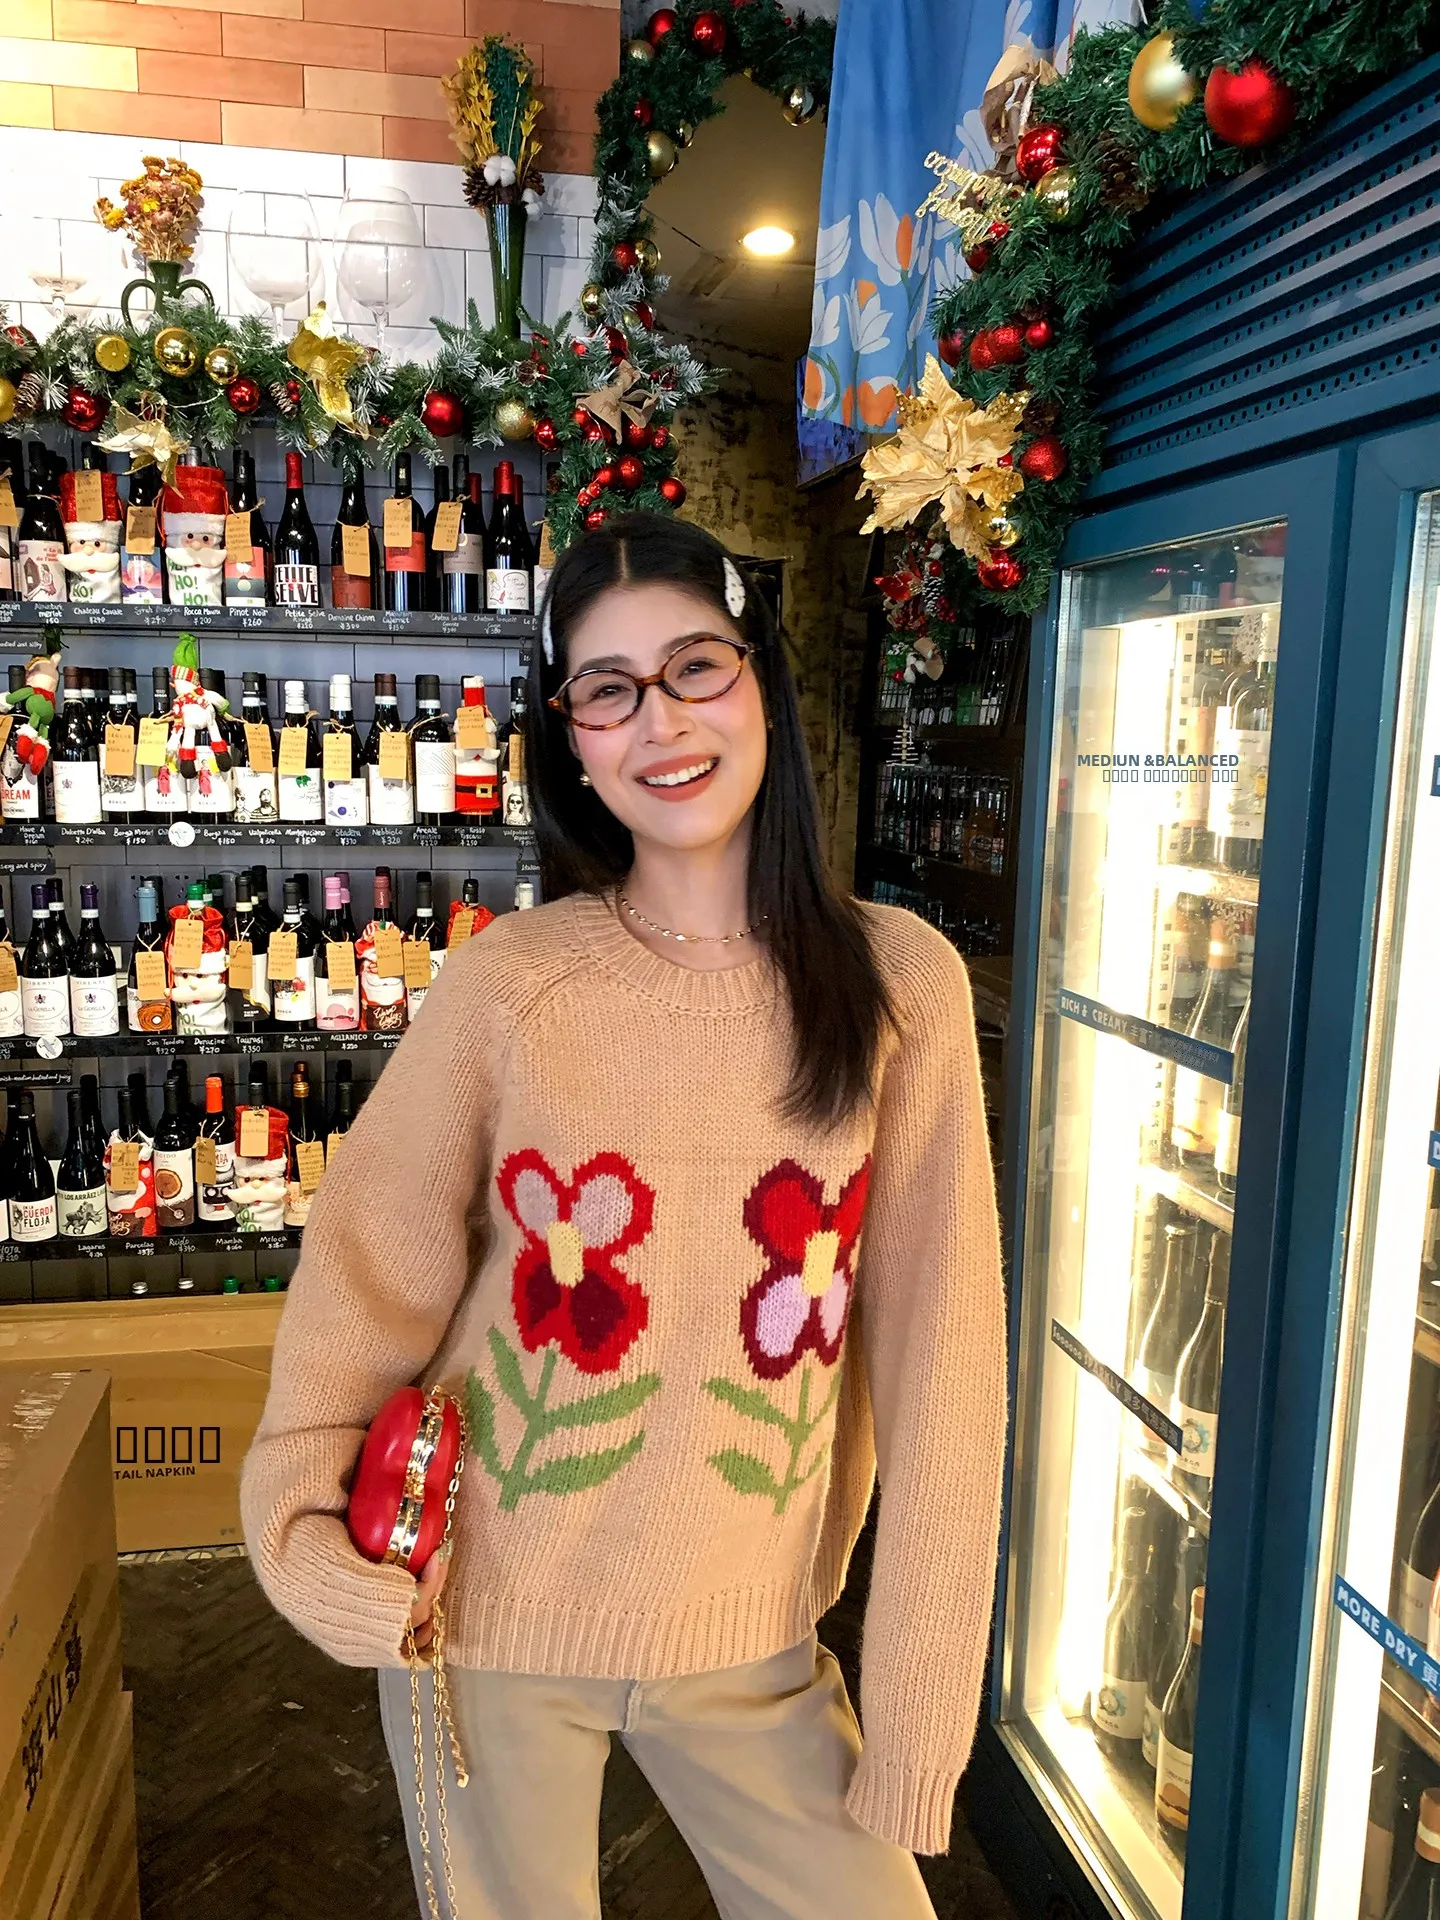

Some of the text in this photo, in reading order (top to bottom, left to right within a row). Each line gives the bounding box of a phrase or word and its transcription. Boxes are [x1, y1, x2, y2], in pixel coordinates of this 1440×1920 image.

[174, 575, 199, 590] HO!
[73, 584, 94, 600] HO!
[229, 607, 250, 617] Pinot
[1077, 754, 1239, 767] MEDIUN &BALANCED
[371, 828, 404, 836] Nebbiolo
[1061, 996, 1128, 1034] RICH & CREAMY
[235, 1035, 265, 1046] Taurasi
[199, 1046, 221, 1055] ¥270
[64, 1193, 74, 1201] LOS
[23, 1216, 51, 1228] FLOJA
[215, 1236, 244, 1246] Mamba
[1083, 1351, 1122, 1394] SPARKLY
[114, 1466, 196, 1480] TAIL NAPKIN
[1337, 1585, 1418, 1667] MORE DRY
[1421, 1660, 1440, 1692] 更
